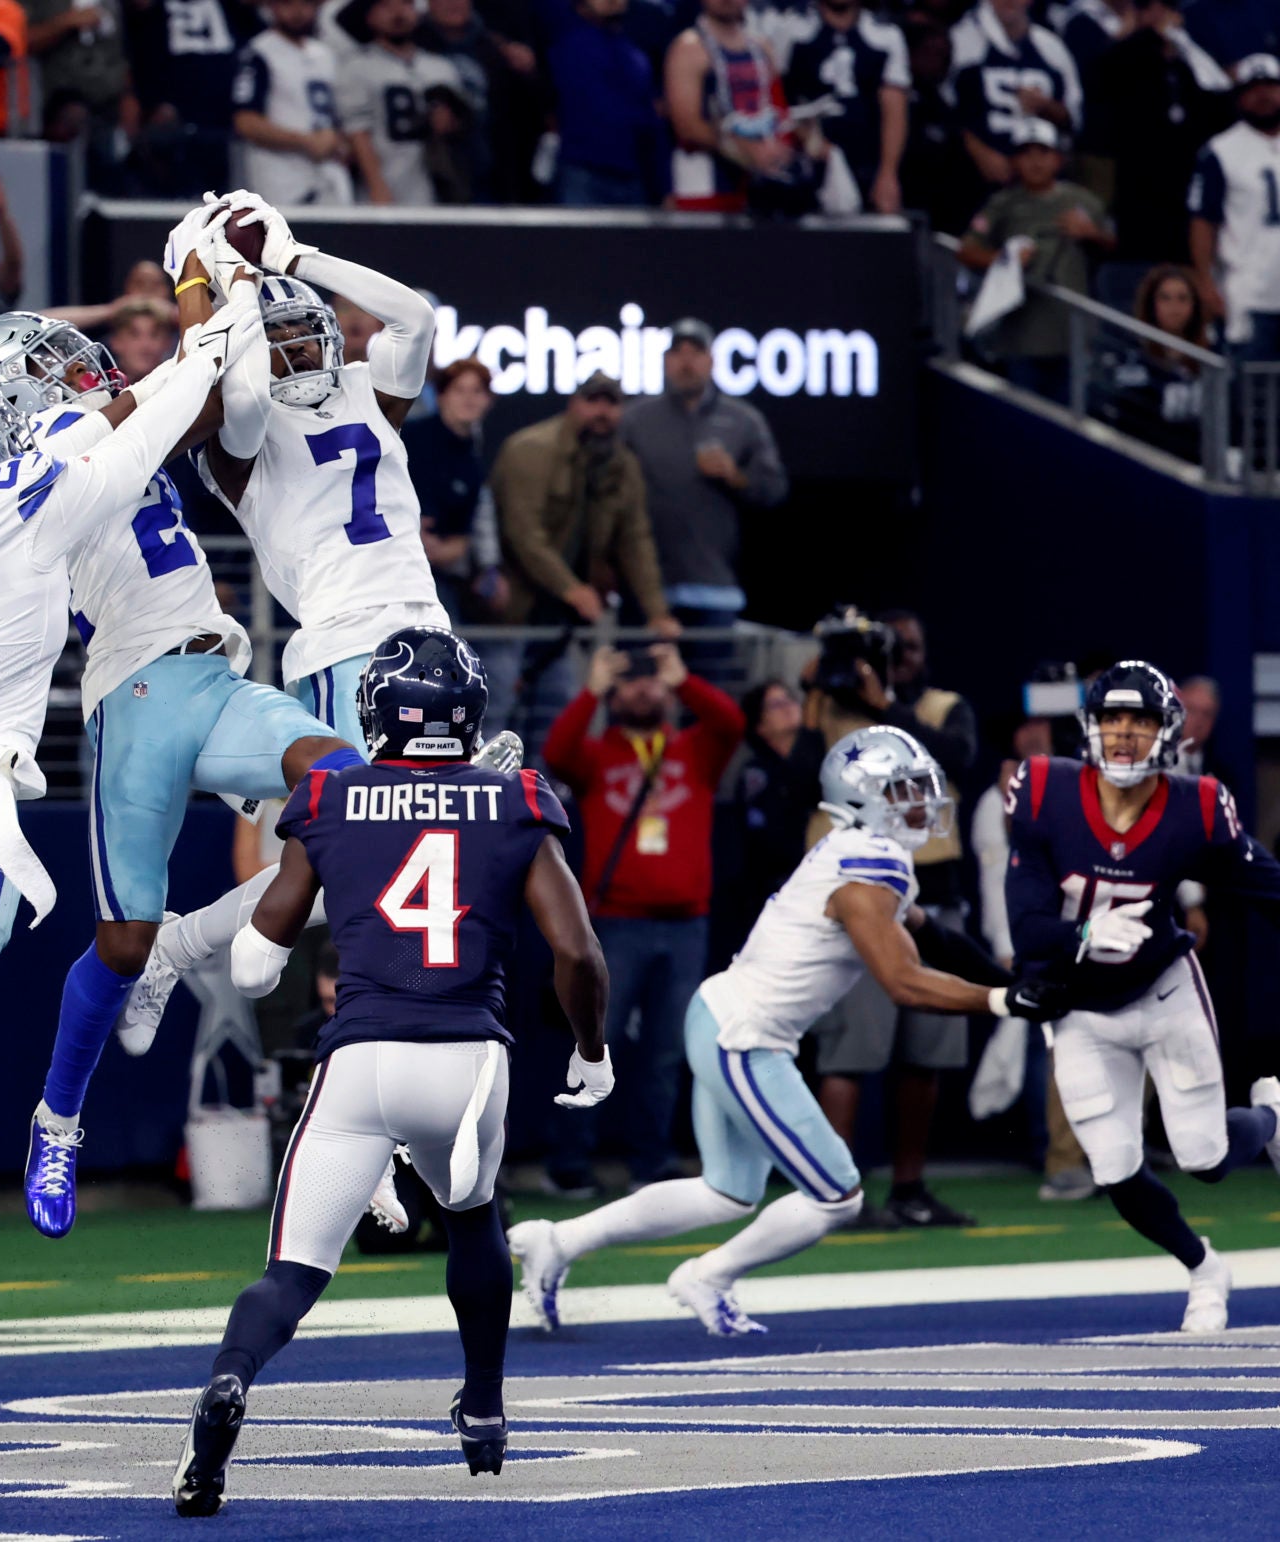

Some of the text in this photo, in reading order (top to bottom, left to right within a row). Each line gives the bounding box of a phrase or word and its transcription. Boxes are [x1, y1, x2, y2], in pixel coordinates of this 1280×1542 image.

[821, 47, 858, 99] 4
[432, 302, 879, 396] kchaircom
[304, 422, 393, 545] 7
[415, 742, 456, 750] STOP HATE
[345, 783, 503, 821] DORSETT
[373, 828, 471, 968] 4
